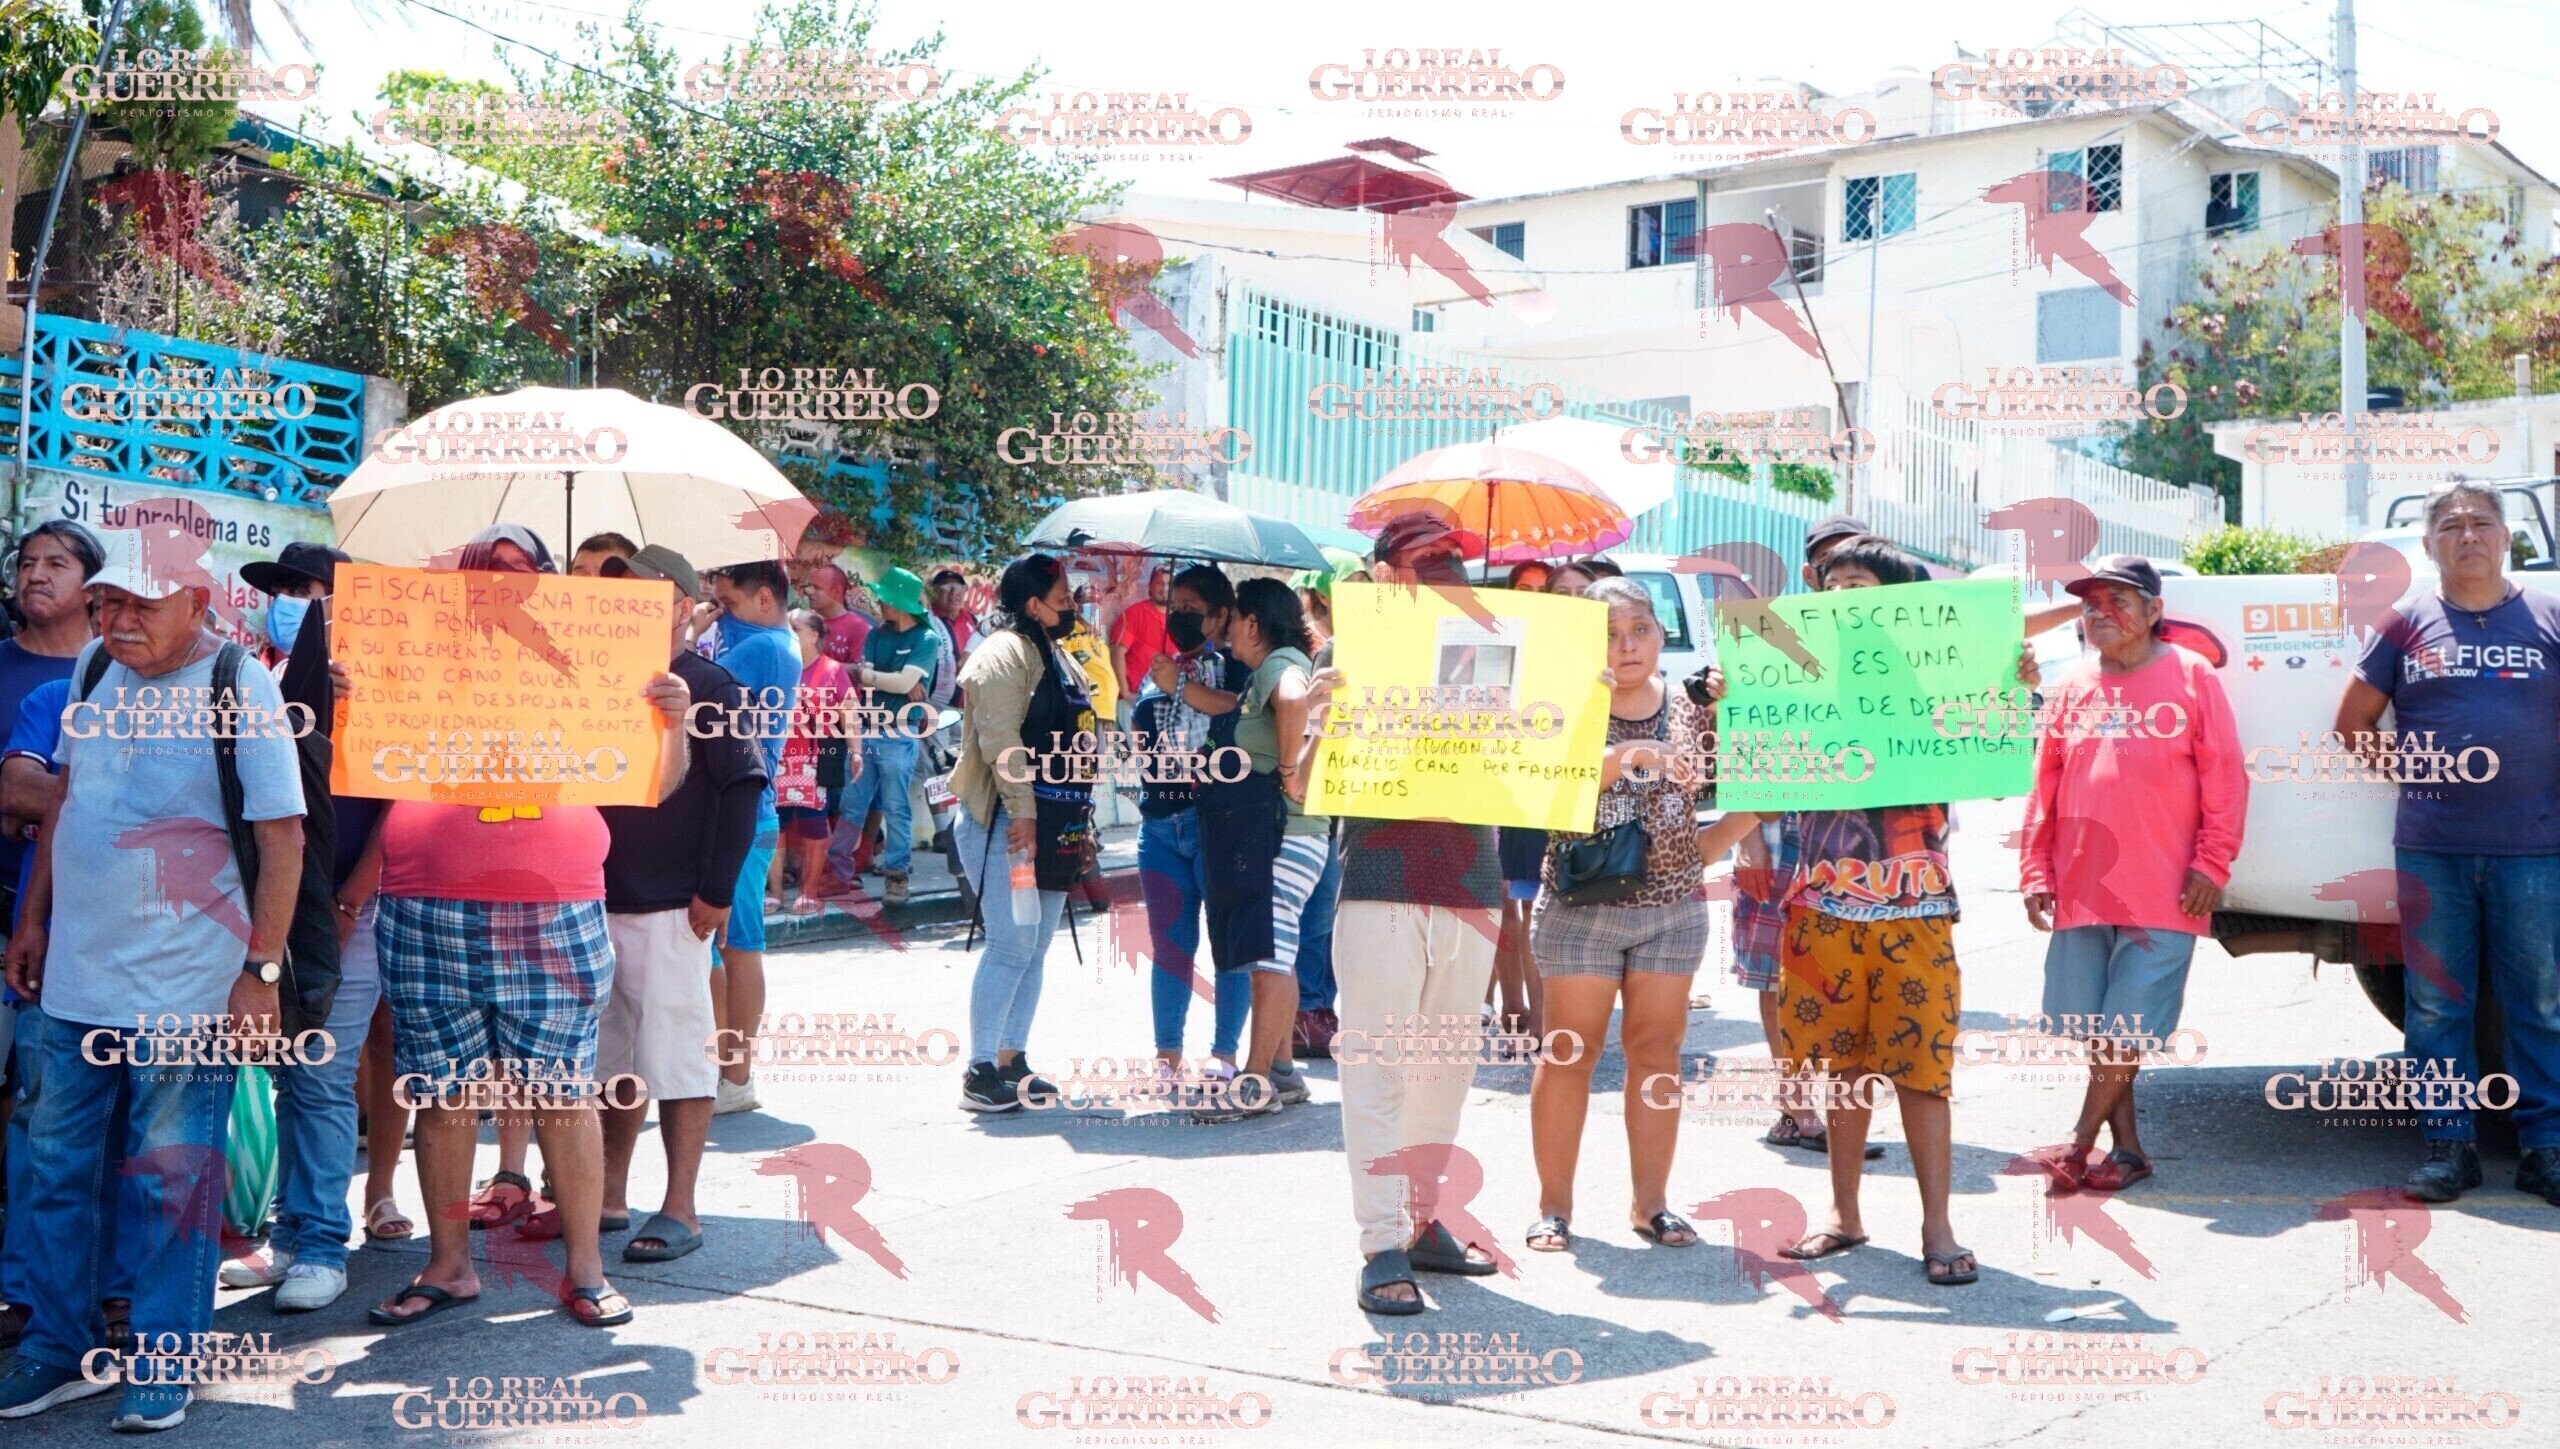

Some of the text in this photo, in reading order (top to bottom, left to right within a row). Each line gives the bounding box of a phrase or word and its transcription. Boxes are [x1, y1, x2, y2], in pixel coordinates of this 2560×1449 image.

[61, 480, 88, 520] Si
[100, 485, 127, 527] tu
[247, 520, 271, 547] es
[226, 572, 259, 609] las
[352, 577, 665, 619] FISCAL ZIPACNA TORRES
[339, 607, 640, 639] OJEDA PONGA ATENCION
[1733, 604, 1961, 639] LA FISCALIA
[2250, 606, 2332, 630] 911
[337, 636, 609, 667] A SU ELEMENTO AURELIO
[2244, 639, 2345, 652] EMERGENCIAS
[443, 668, 501, 682] CANO
[519, 671, 580, 689] QUIEN
[598, 674, 627, 690] SE
[1740, 645, 1964, 688] SOLO ES UNA
[350, 687, 635, 711] EDICA A DESPOJAR DE
[1727, 703, 1842, 728] FABRICA
[1858, 695, 1896, 716] DE
[335, 711, 646, 733] SUS PROPIEDADES A GENTE
[1888, 734, 2014, 758] INVESTIGA
[1327, 751, 1600, 783] AURELIO CANO POR FABRICAR
[1324, 778, 1410, 797] DELITOS
